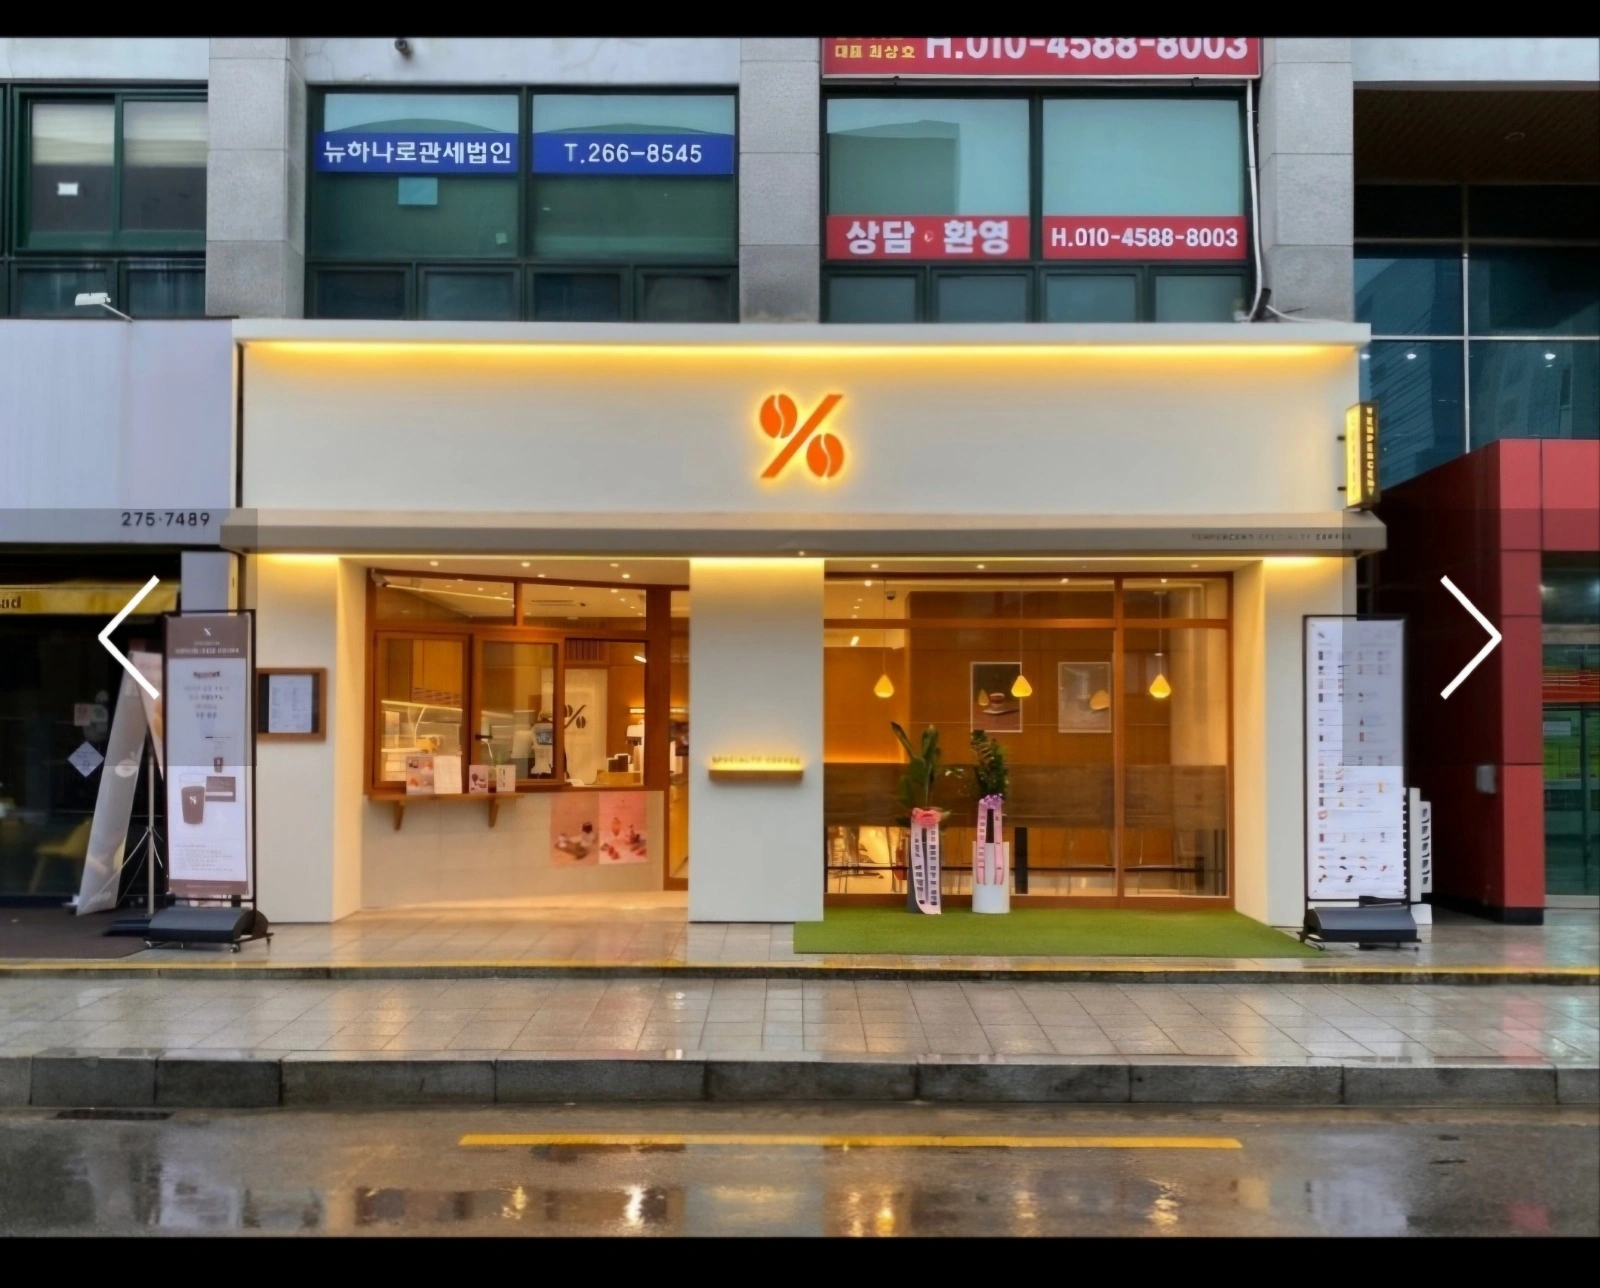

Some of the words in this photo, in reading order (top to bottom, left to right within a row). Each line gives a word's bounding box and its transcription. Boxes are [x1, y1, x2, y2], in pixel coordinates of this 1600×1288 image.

[925, 37, 1248, 60] H.010-4588-8003
[323, 140, 511, 165] 뉴하나로관세법인
[563, 142, 702, 165] T.266-8545
[845, 219, 915, 255] 상담
[943, 219, 1010, 255] 환영
[1051, 227, 1238, 247] H.010-4588-8003
